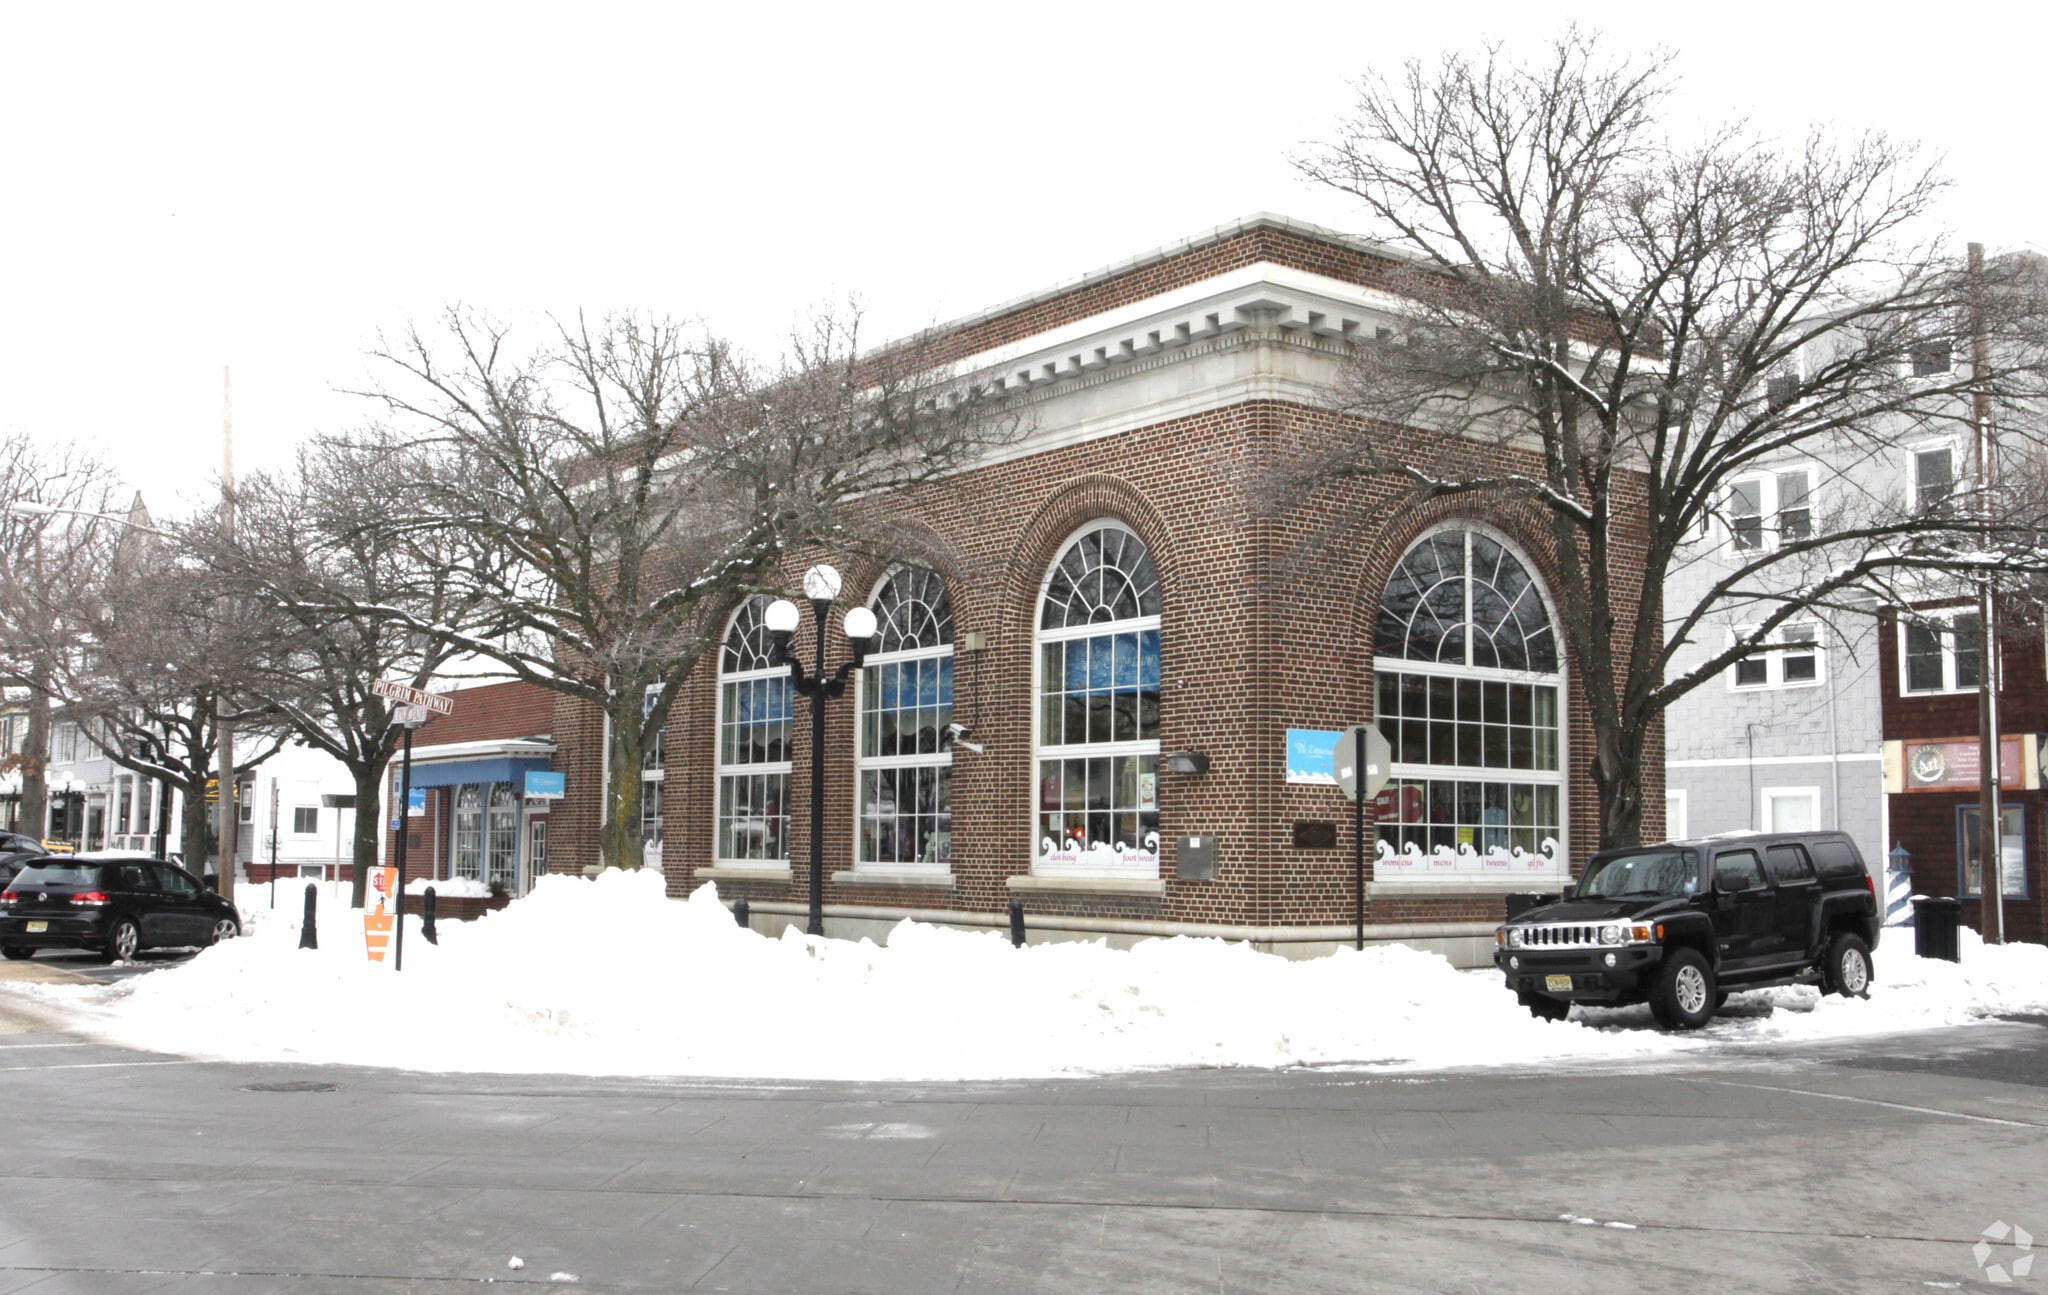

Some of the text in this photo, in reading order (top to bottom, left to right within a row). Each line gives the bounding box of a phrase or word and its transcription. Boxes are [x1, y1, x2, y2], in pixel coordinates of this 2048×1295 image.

[375, 681, 451, 712] PILGRIM PATHWAY
[1919, 757, 1939, 775] Art
